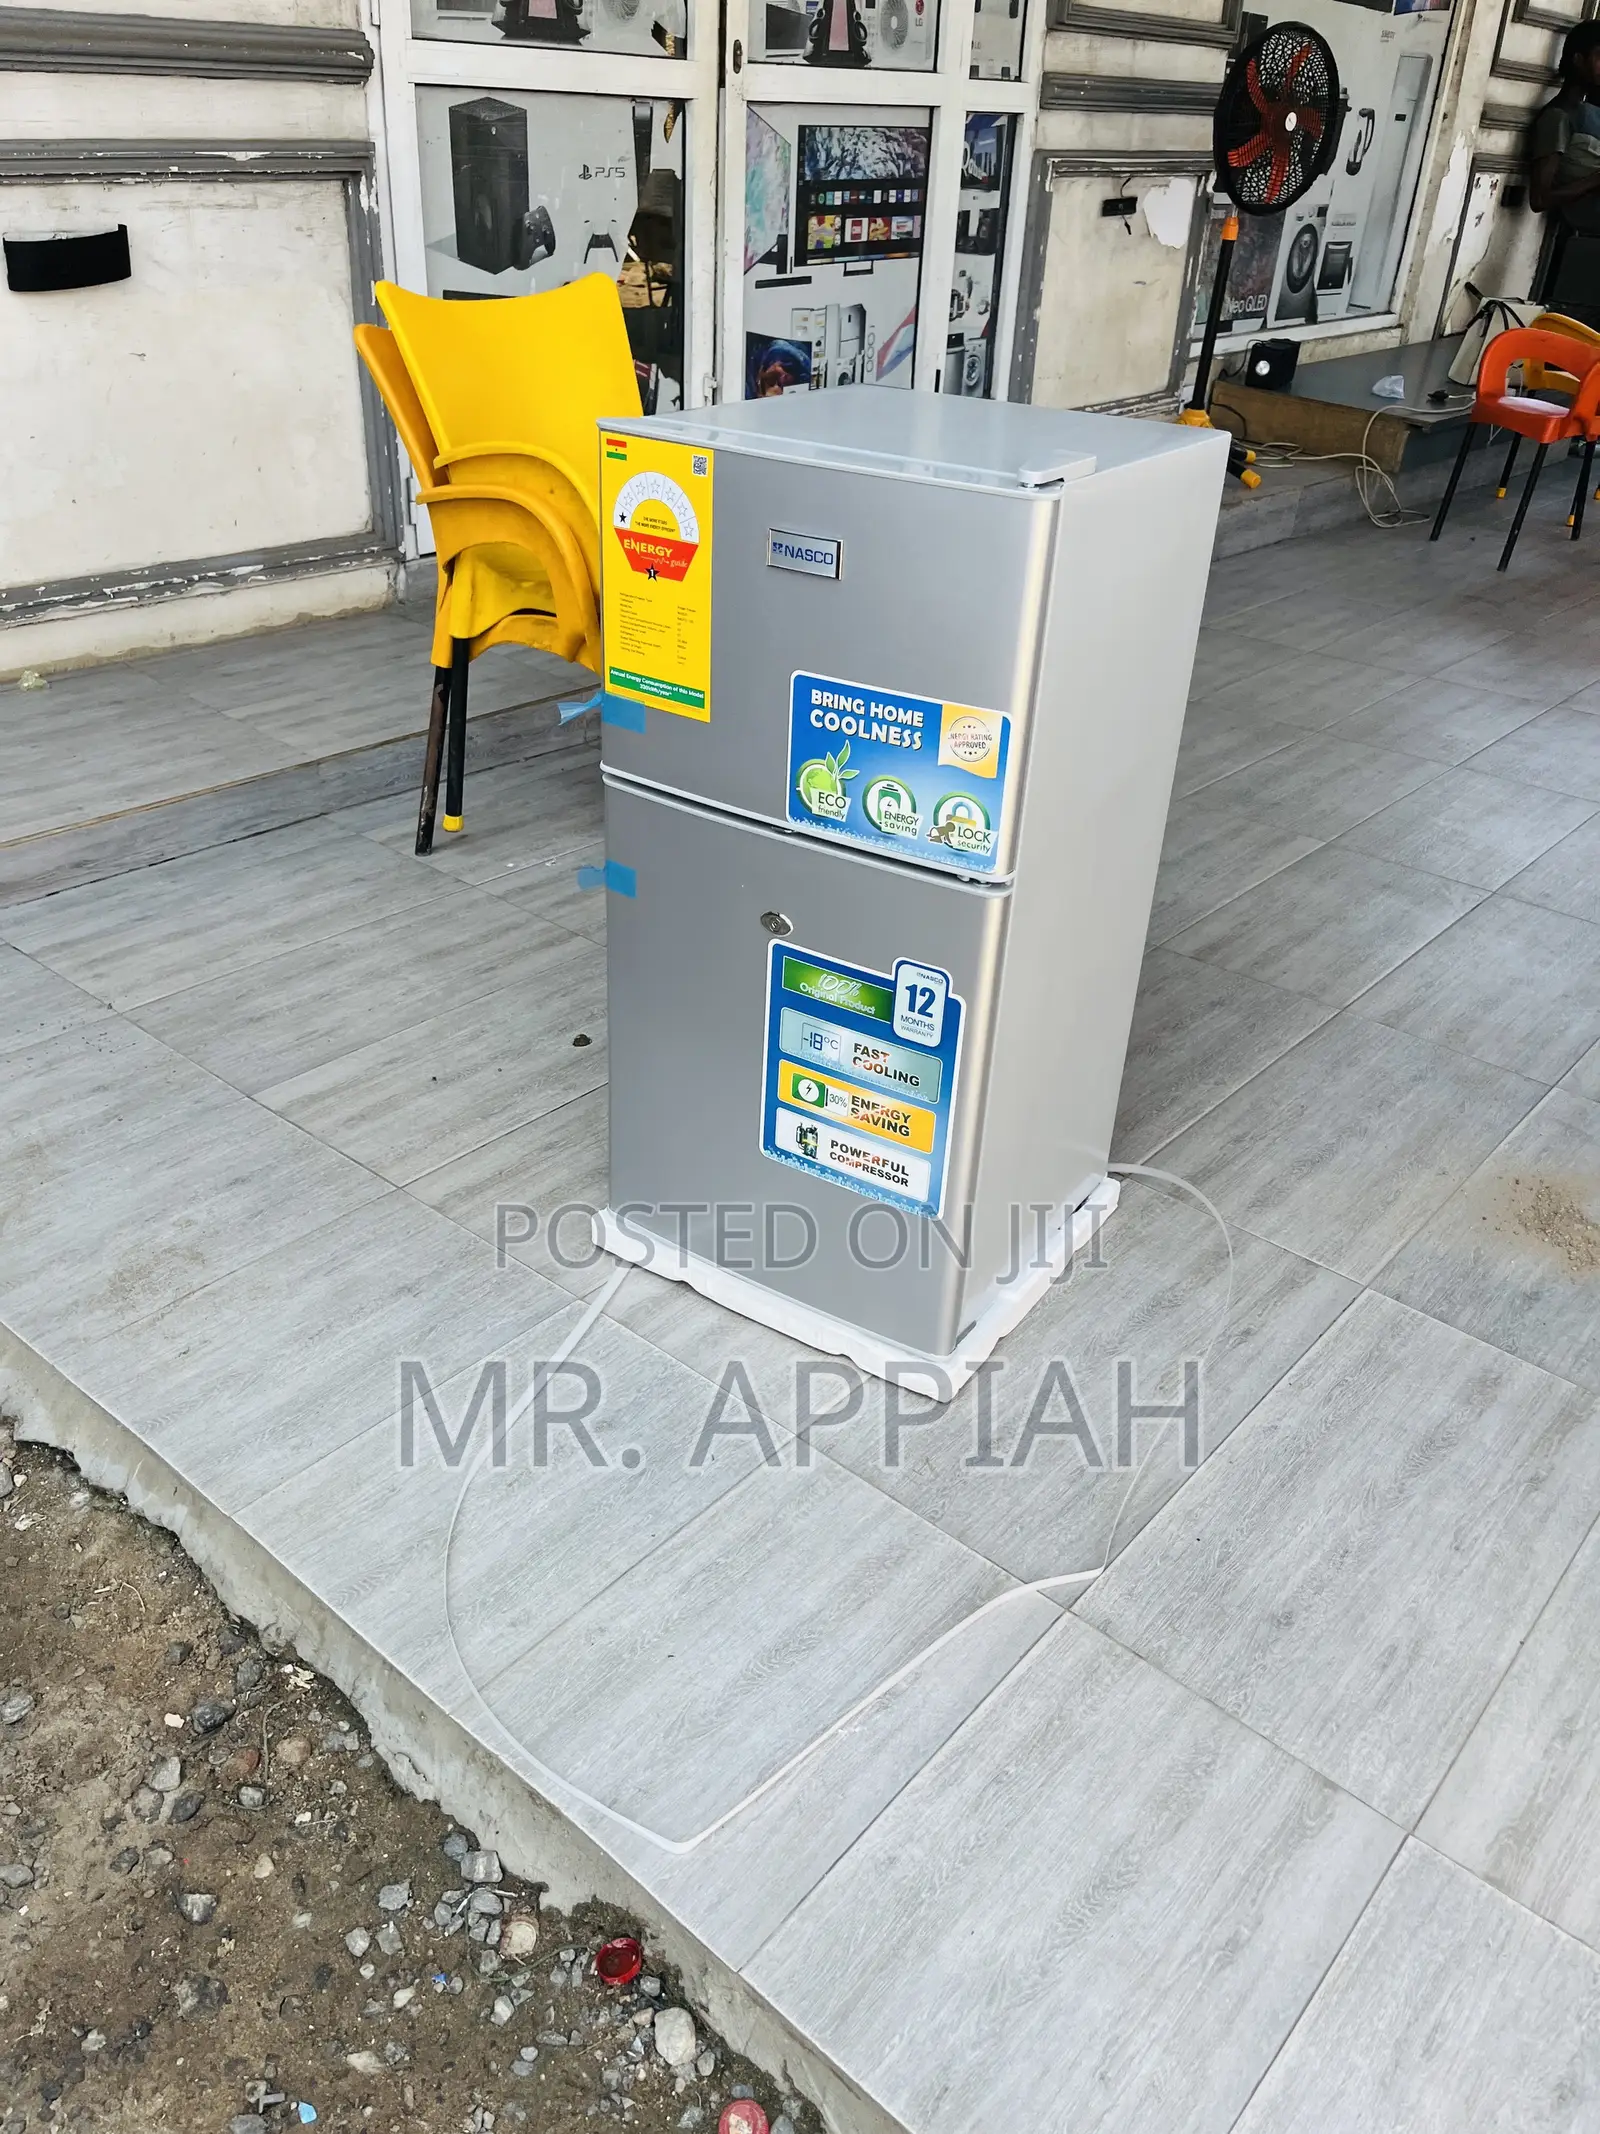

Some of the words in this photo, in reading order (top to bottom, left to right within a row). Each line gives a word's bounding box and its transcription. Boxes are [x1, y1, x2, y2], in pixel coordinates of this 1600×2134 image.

[915, 17, 924, 27] LG
[595, 166, 626, 178] PS5
[1245, 294, 1268, 312] QLED
[623, 538, 673, 558] ENERGY
[784, 544, 834, 565] NASCO
[626, 673, 641, 683] Energy
[641, 678, 673, 691] Consumption
[679, 685, 688, 694] this
[811, 689, 865, 715] BRING
[870, 701, 924, 728] HOME
[809, 708, 923, 751] COOLNESS
[954, 740, 987, 750] APPROVED
[818, 791, 847, 810] ECO
[817, 804, 846, 821] friendly
[884, 810, 920, 827] ENERGY
[884, 820, 918, 837] saving
[957, 825, 991, 844] LOCK
[957, 840, 991, 854] security
[818, 973, 863, 997] 100%
[800, 982, 838, 1002] Original
[839, 993, 876, 1015] Product
[905, 983, 936, 1019] 12
[900, 1014, 935, 1032] MONTHS
[900, 1025, 934, 1038] WARRANTY
[853, 1042, 890, 1063] FAST
[852, 1056, 920, 1087] COOLING
[829, 1093, 848, 1109] 30%
[851, 1094, 912, 1125] ENERGY
[850, 1107, 910, 1137] SAVING
[830, 1139, 909, 1177] POWERFUL
[829, 1151, 909, 1187] COMPRESSOR
